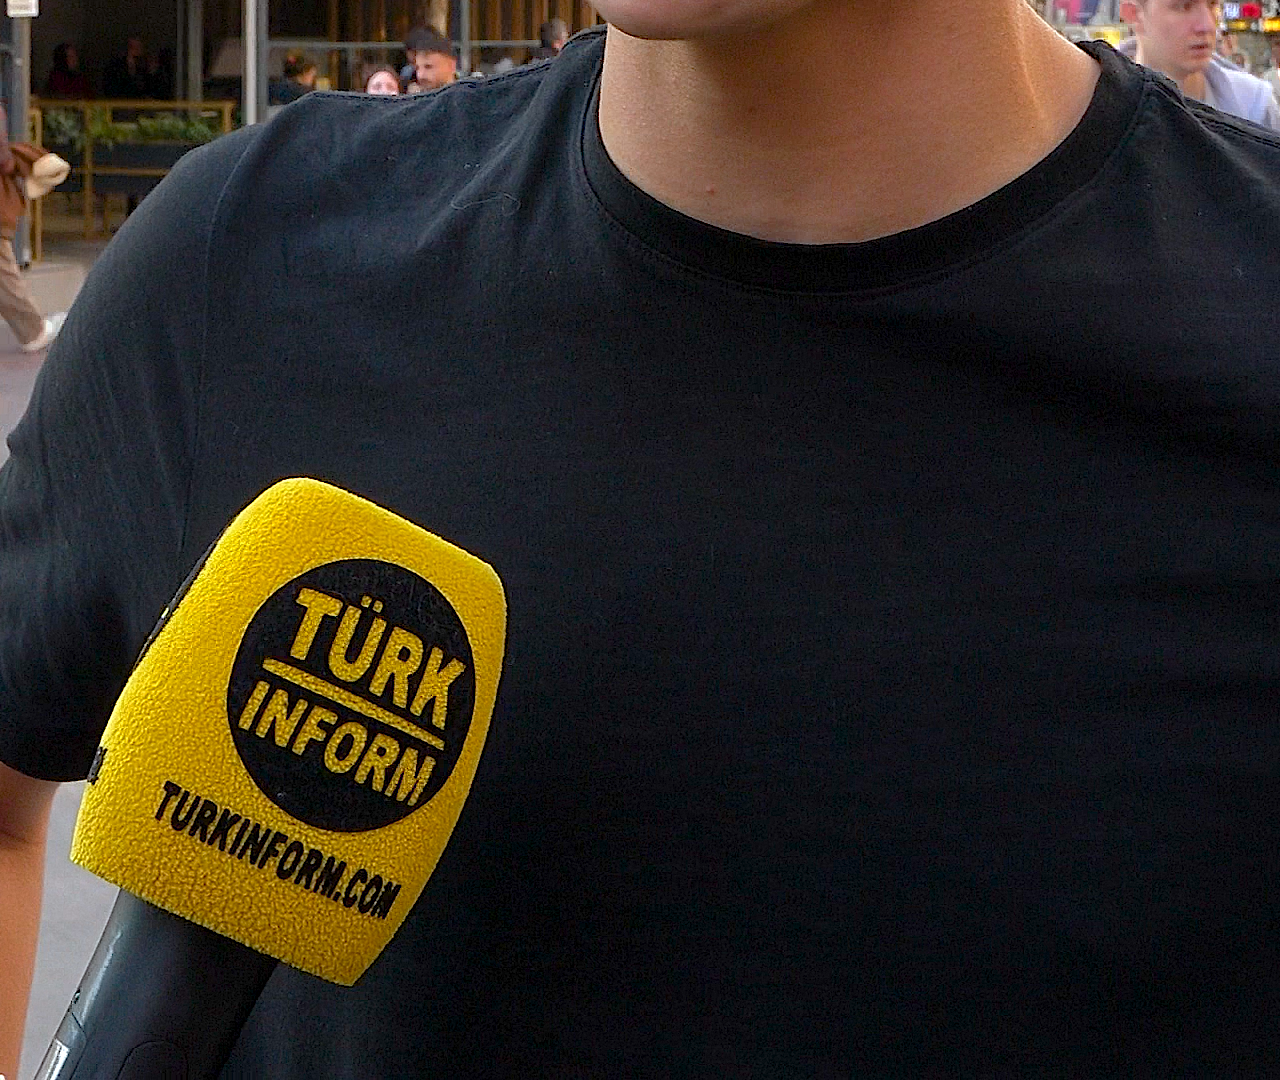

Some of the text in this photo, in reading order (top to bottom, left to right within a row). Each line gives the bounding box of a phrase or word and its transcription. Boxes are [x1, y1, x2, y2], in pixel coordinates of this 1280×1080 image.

[290, 587, 467, 731] TÜRK
[237, 680, 437, 807] INFORM
[154, 779, 403, 920] TURKINFORM.COM
